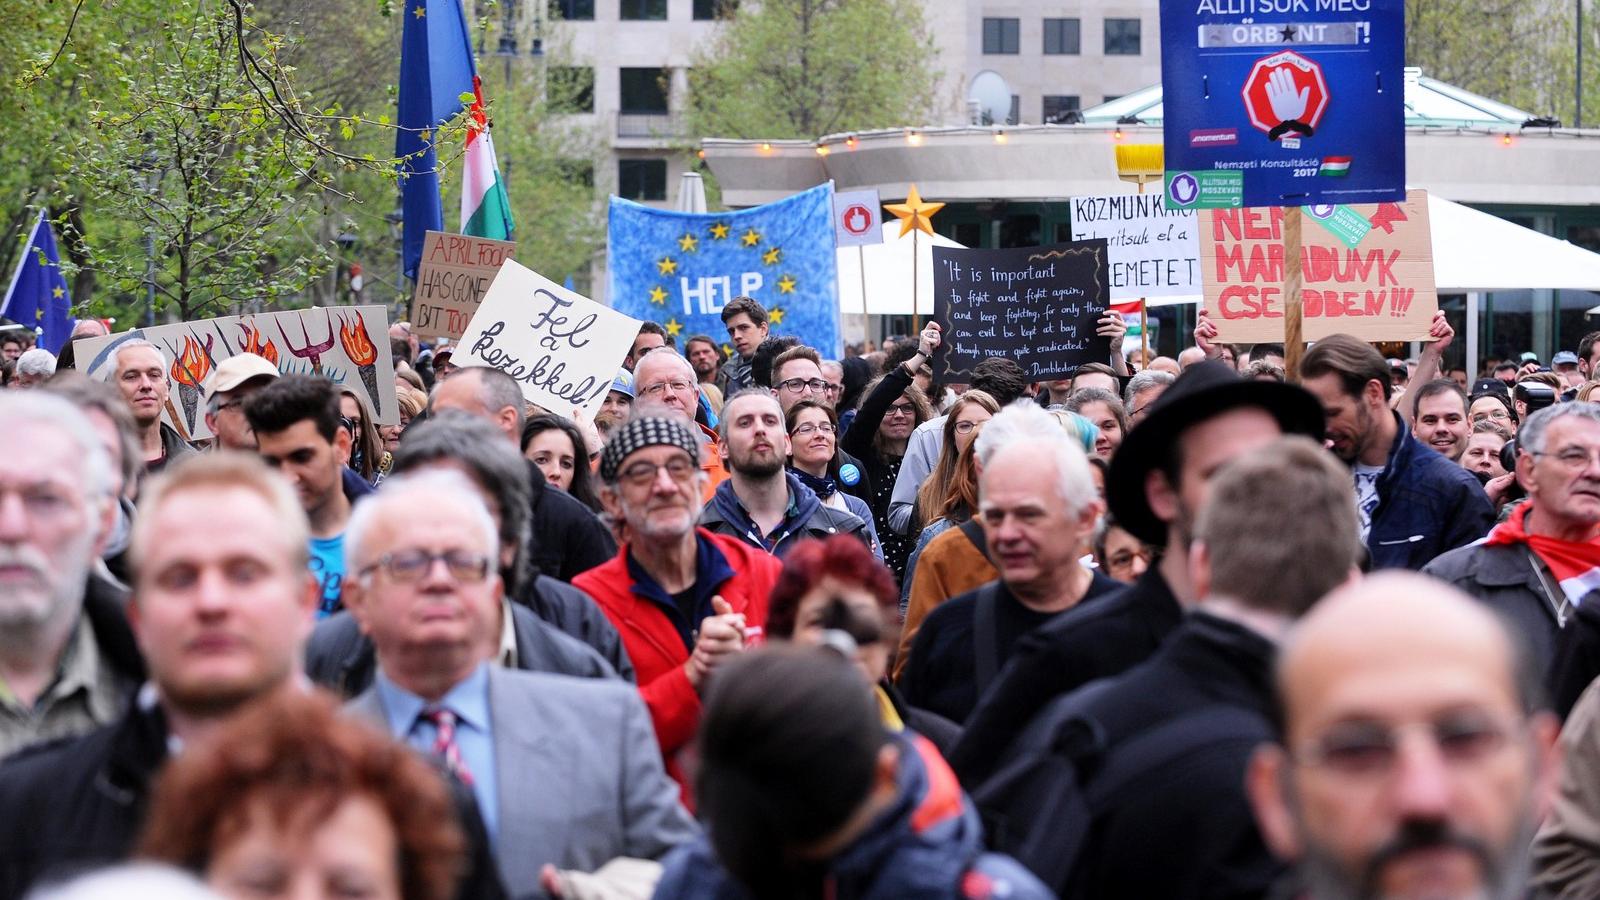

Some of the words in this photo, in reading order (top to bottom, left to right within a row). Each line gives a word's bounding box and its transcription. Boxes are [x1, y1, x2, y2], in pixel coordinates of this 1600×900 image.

[1232, 18, 1328, 43] ÖRBNT
[1192, 134, 1236, 142] momentum
[1214, 160, 1258, 169] Nemzeti
[1260, 158, 1319, 168] Konzultáció
[1293, 168, 1317, 177] 2017
[1157, 223, 1174, 241] el
[1178, 230, 1187, 240] a
[430, 236, 474, 265] APRIL
[970, 267, 982, 282] is
[991, 263, 1056, 290] important
[1107, 258, 1197, 287] EMETET
[420, 269, 452, 299] HAS
[453, 273, 488, 303] GONE
[681, 271, 763, 315] HELP
[950, 288, 962, 304] to
[968, 289, 990, 307] fight
[997, 291, 1020, 303] and
[1025, 288, 1048, 304] fight
[1052, 287, 1085, 301] again,
[953, 311, 972, 320] and
[980, 311, 998, 324] keep
[1043, 304, 1056, 321] for
[1061, 303, 1080, 318] only
[1083, 301, 1105, 313] then
[1218, 285, 1414, 319] CSEDBEN!!!
[417, 303, 444, 329] BIT
[446, 309, 468, 334] TOO
[530, 288, 598, 349] Fel
[956, 330, 973, 338] can
[978, 326, 996, 337] evil
[1003, 325, 1016, 338] be
[1021, 324, 1037, 340] kept
[1043, 321, 1055, 333] at
[1060, 319, 1077, 338] bay
[540, 336, 560, 351] a
[954, 342, 980, 359] though
[985, 348, 1008, 357] never
[471, 321, 612, 408] kezekkel!
